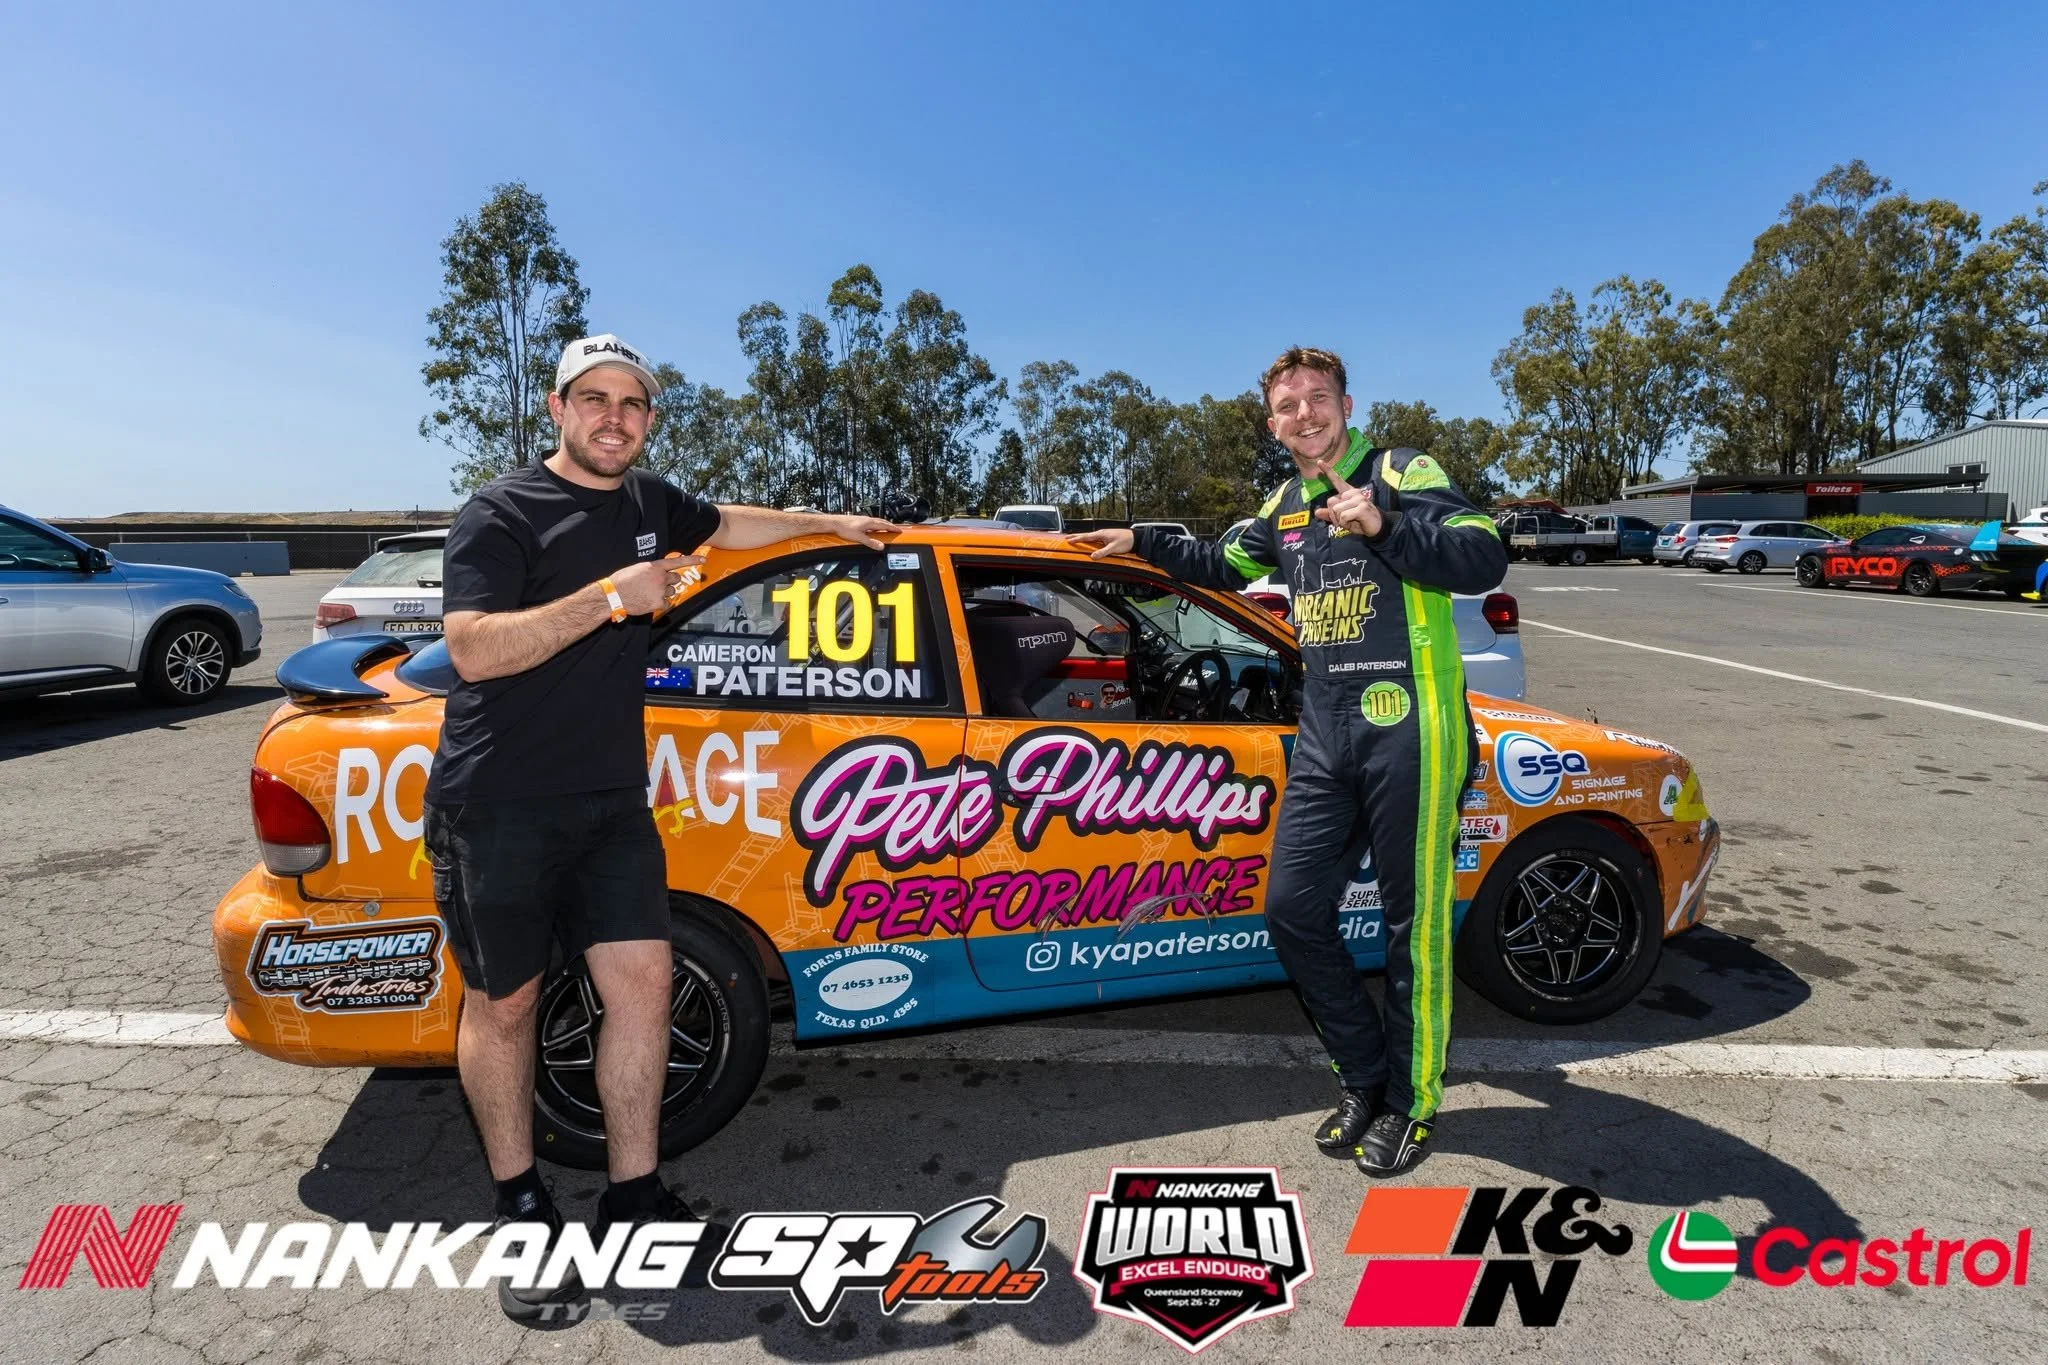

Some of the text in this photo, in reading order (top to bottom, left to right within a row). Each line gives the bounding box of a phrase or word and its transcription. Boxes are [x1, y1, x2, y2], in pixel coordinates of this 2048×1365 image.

[583, 341, 641, 365] BLAHST
[1815, 484, 1853, 494] Toilets
[1831, 556, 1898, 577] RYCO
[772, 579, 915, 662] 101
[1299, 615, 1362, 643] PROTEINS
[1018, 631, 1067, 649] rpm
[667, 644, 776, 663] CAMERON
[1328, 660, 1407, 672] CALEB PATERSON
[696, 665, 921, 698] PATERSON
[1367, 689, 1402, 718] 101
[1518, 752, 1589, 777] SSQ
[1571, 775, 1626, 790] SIGNAGE
[1554, 788, 1643, 806] AND PRINTING
[801, 735, 1266, 896] Pete Phillips
[835, 856, 1266, 942] PERFORMANCE
[1349, 889, 1380, 900] SUPE
[844, 943, 890, 957] FAMILY
[891, 944, 929, 963] STORE
[305, 975, 430, 1004] Industries
[822, 973, 909, 993] 07 4653 1238
[326, 994, 416, 1006] 07 32851004
[707, 979, 730, 1034] RACING
[815, 1011, 855, 1028] TEXAS
[893, 998, 918, 1019] 4385
